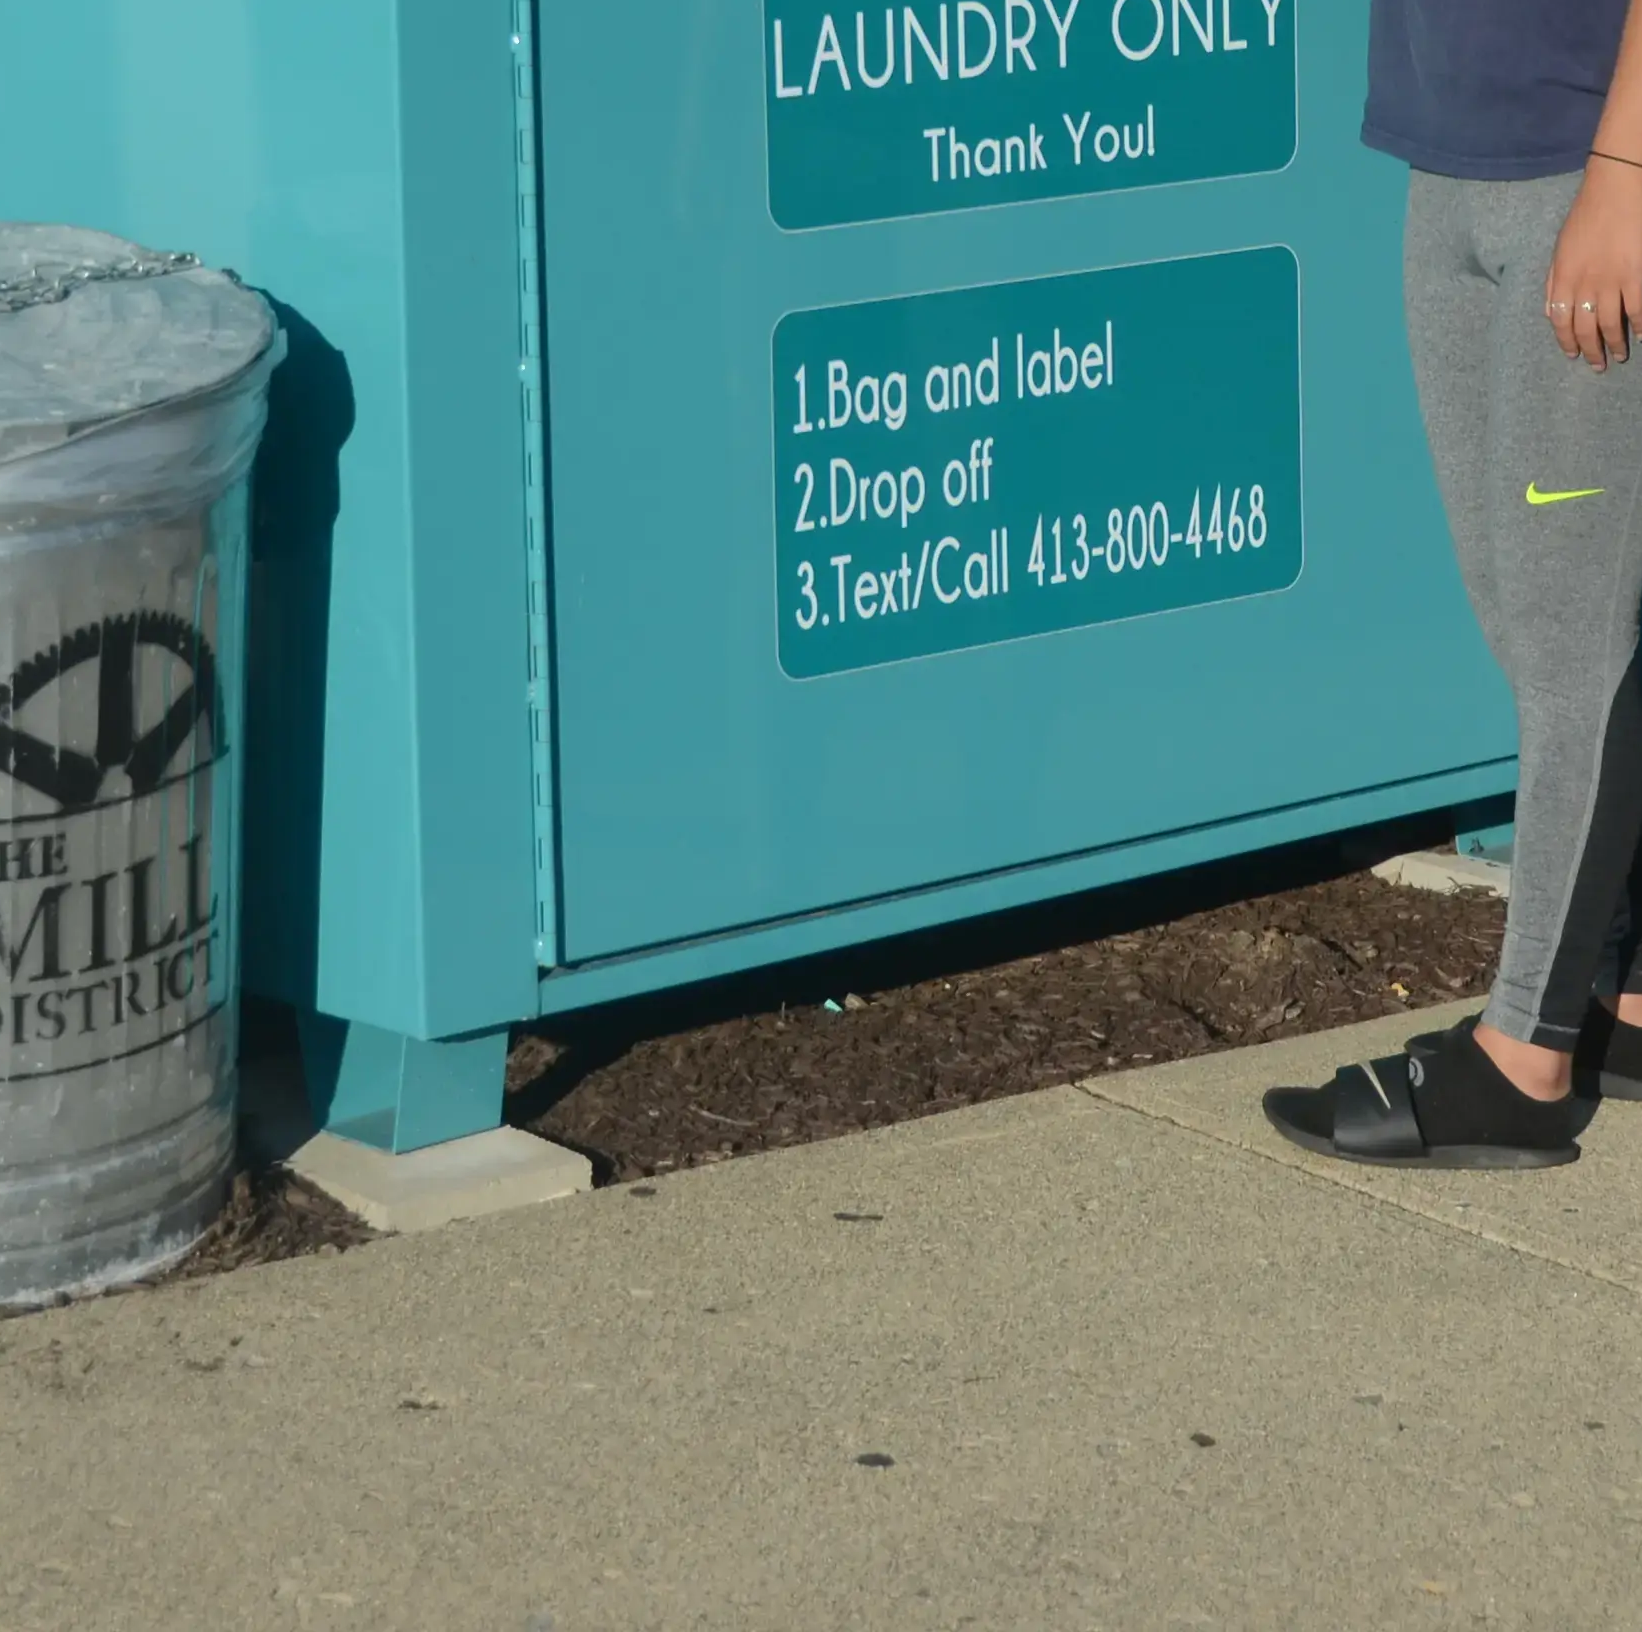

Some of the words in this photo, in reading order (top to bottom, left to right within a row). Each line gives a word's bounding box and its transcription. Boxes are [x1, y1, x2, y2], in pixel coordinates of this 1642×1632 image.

[922, 123, 1048, 182] Thank
[1062, 104, 1156, 165] You!
[791, 358, 907, 434] 1.Bag
[923, 336, 1000, 412] and
[1016, 319, 1115, 399] label
[793, 457, 926, 533] 2.Drop
[942, 435, 994, 507] off
[794, 526, 1009, 630] 3.Text/Call
[1026, 481, 1268, 586] 413-800-4468
